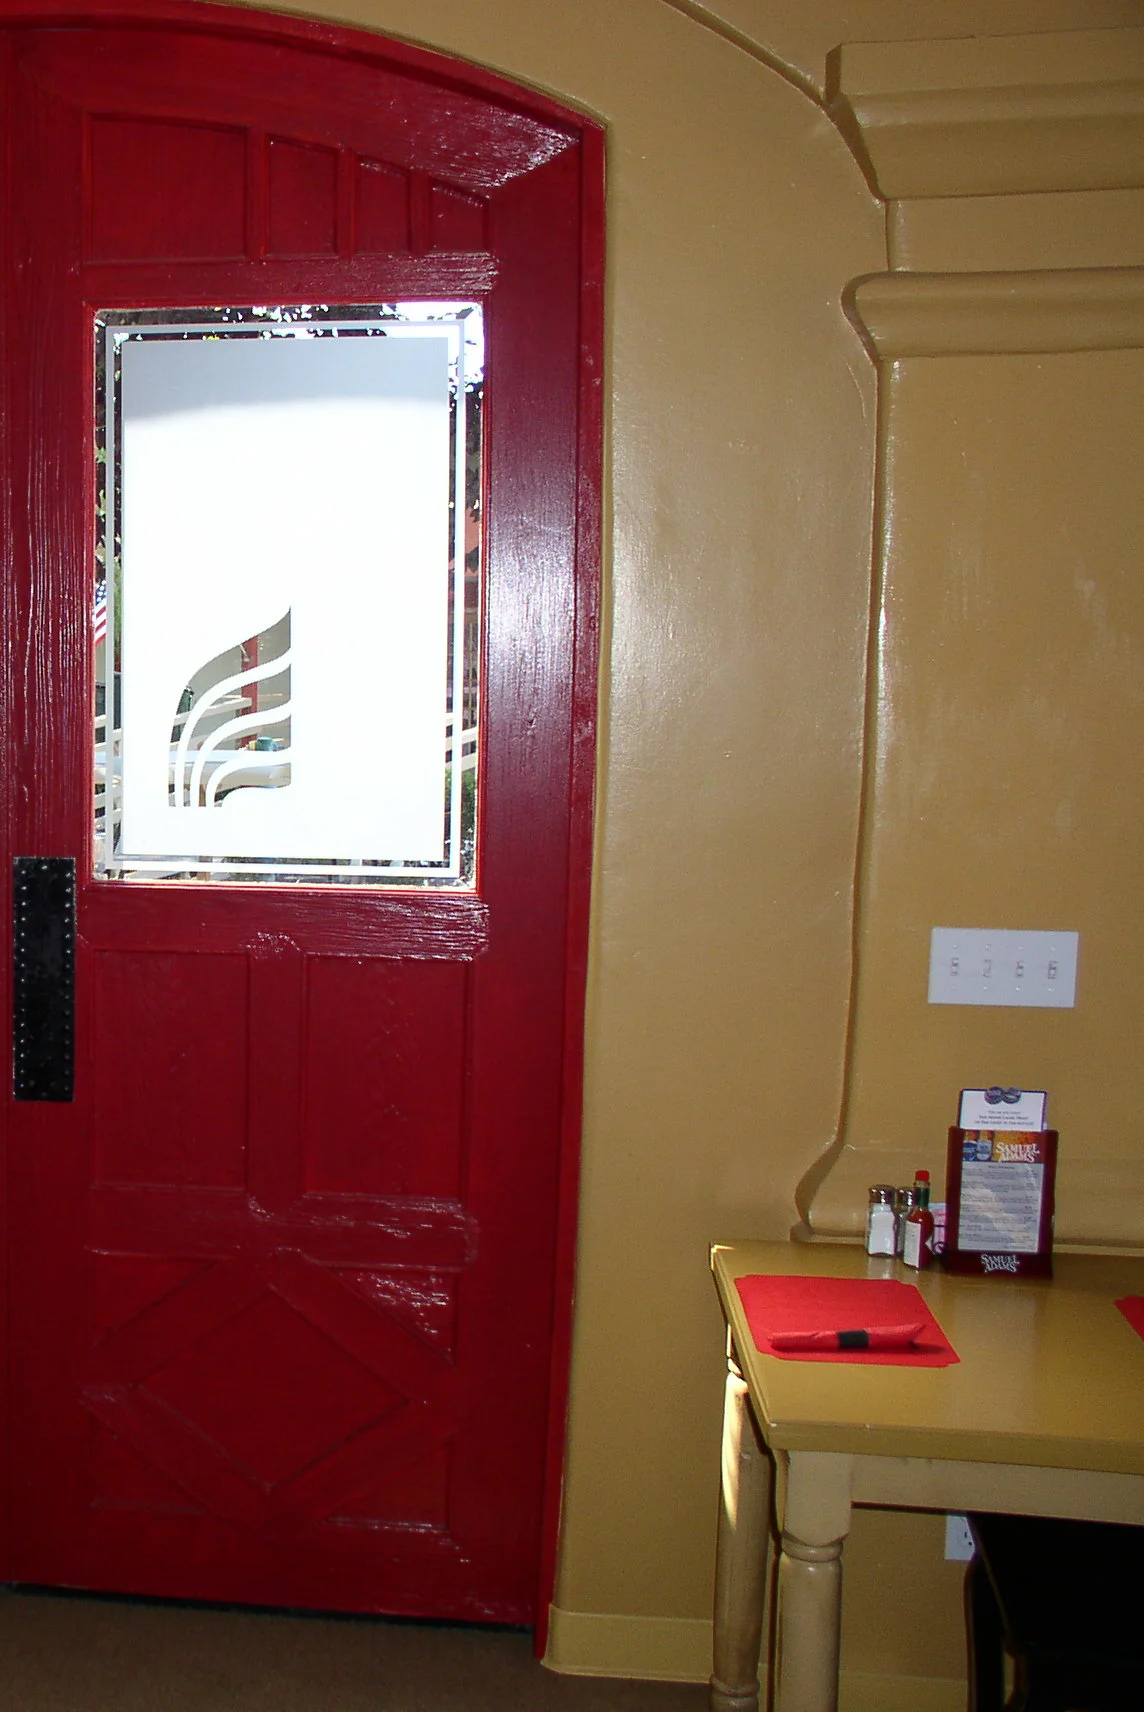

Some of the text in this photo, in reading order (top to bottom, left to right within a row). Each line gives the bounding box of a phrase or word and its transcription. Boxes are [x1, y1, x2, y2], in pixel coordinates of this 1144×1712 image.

[996, 1142, 1040, 1155] SAMUEL
[998, 1150, 1036, 1163] ADAMS
[981, 1253, 1020, 1265] SAMUEL
[984, 1261, 1017, 1273] ADAMS
